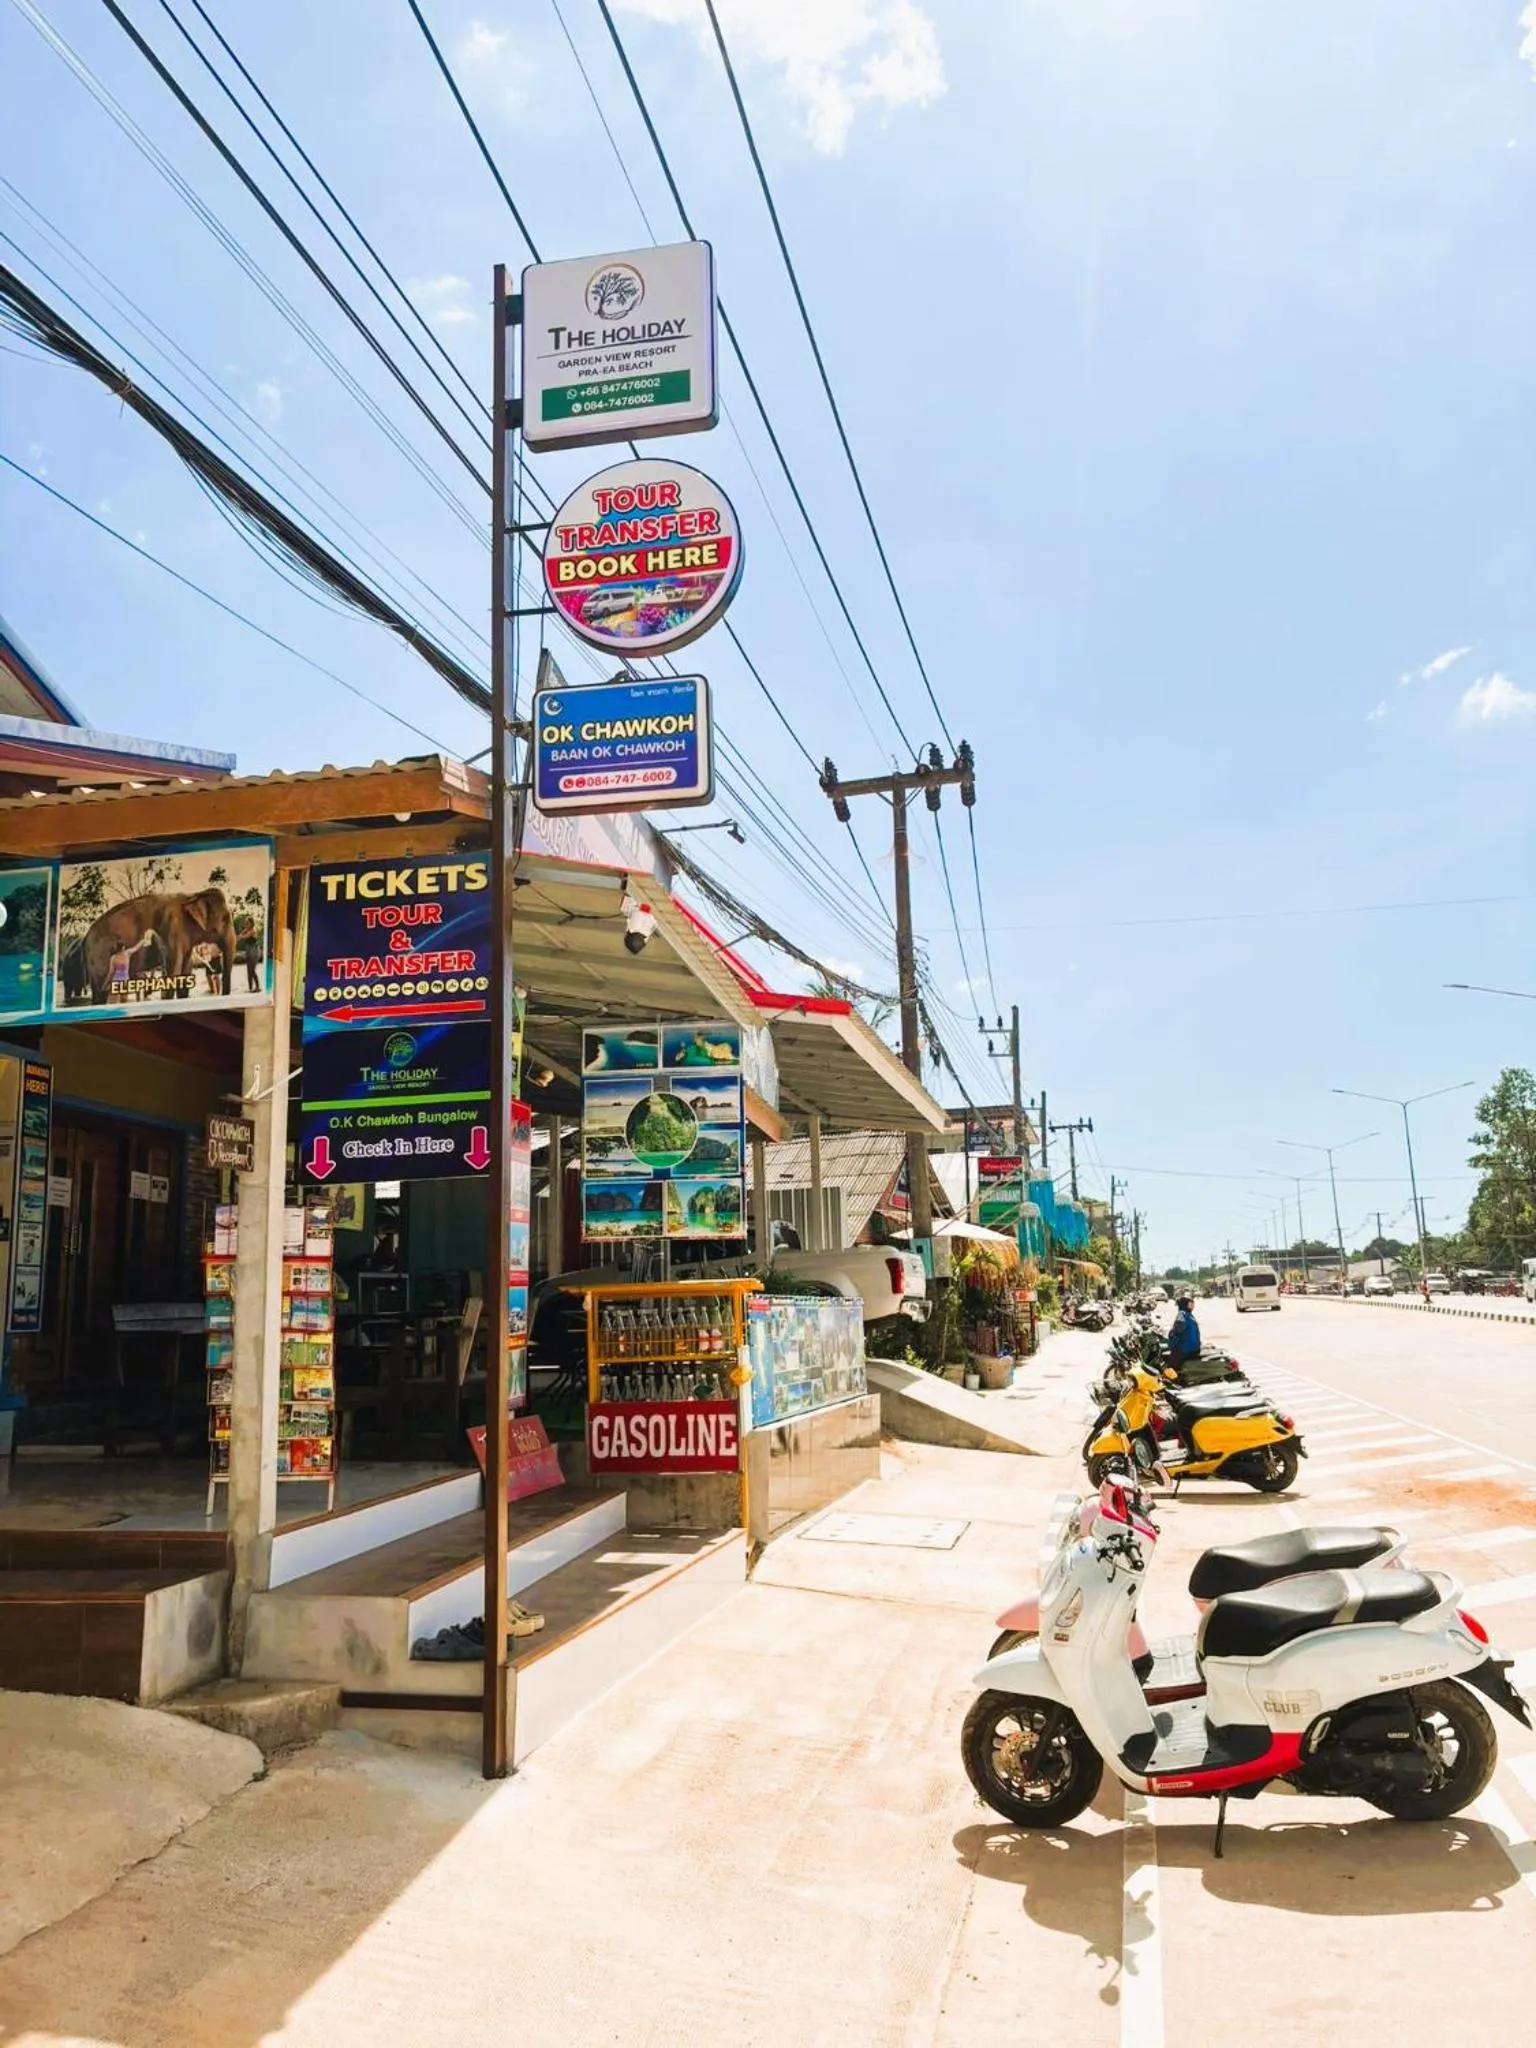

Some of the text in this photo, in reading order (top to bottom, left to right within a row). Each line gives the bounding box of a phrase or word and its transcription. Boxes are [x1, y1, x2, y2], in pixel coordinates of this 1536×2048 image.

[548, 318, 686, 350] THE HOLIDAY
[558, 345, 676, 369] GARDEN VIEW RESORT
[578, 360, 653, 378] PRA-EA BEACH
[580, 378, 660, 397] +66 847476002
[584, 393, 654, 411] 084-7476002
[593, 481, 680, 515] TOUR
[557, 508, 719, 551] TRANSFER
[558, 543, 718, 582] BOOK HERE
[542, 714, 694, 744] OK CHAWKOH
[551, 739, 686, 762] BAAN OK CHAWKOH
[587, 770, 672, 787] 084-747-6002
[320, 863, 488, 901] TICKETS
[362, 903, 443, 929] TOUR
[389, 930, 414, 950] &
[328, 950, 476, 980] TRANSFER
[111, 974, 196, 995] ELEPHANTS
[360, 1067, 439, 1082] THE HOLIDAY
[329, 1109, 478, 1129] O.K Chawkoh Bungalow
[343, 1137, 455, 1158] Check In Here
[591, 1413, 738, 1459] GASOLINE
[1263, 1700, 1301, 1714] CLUB
